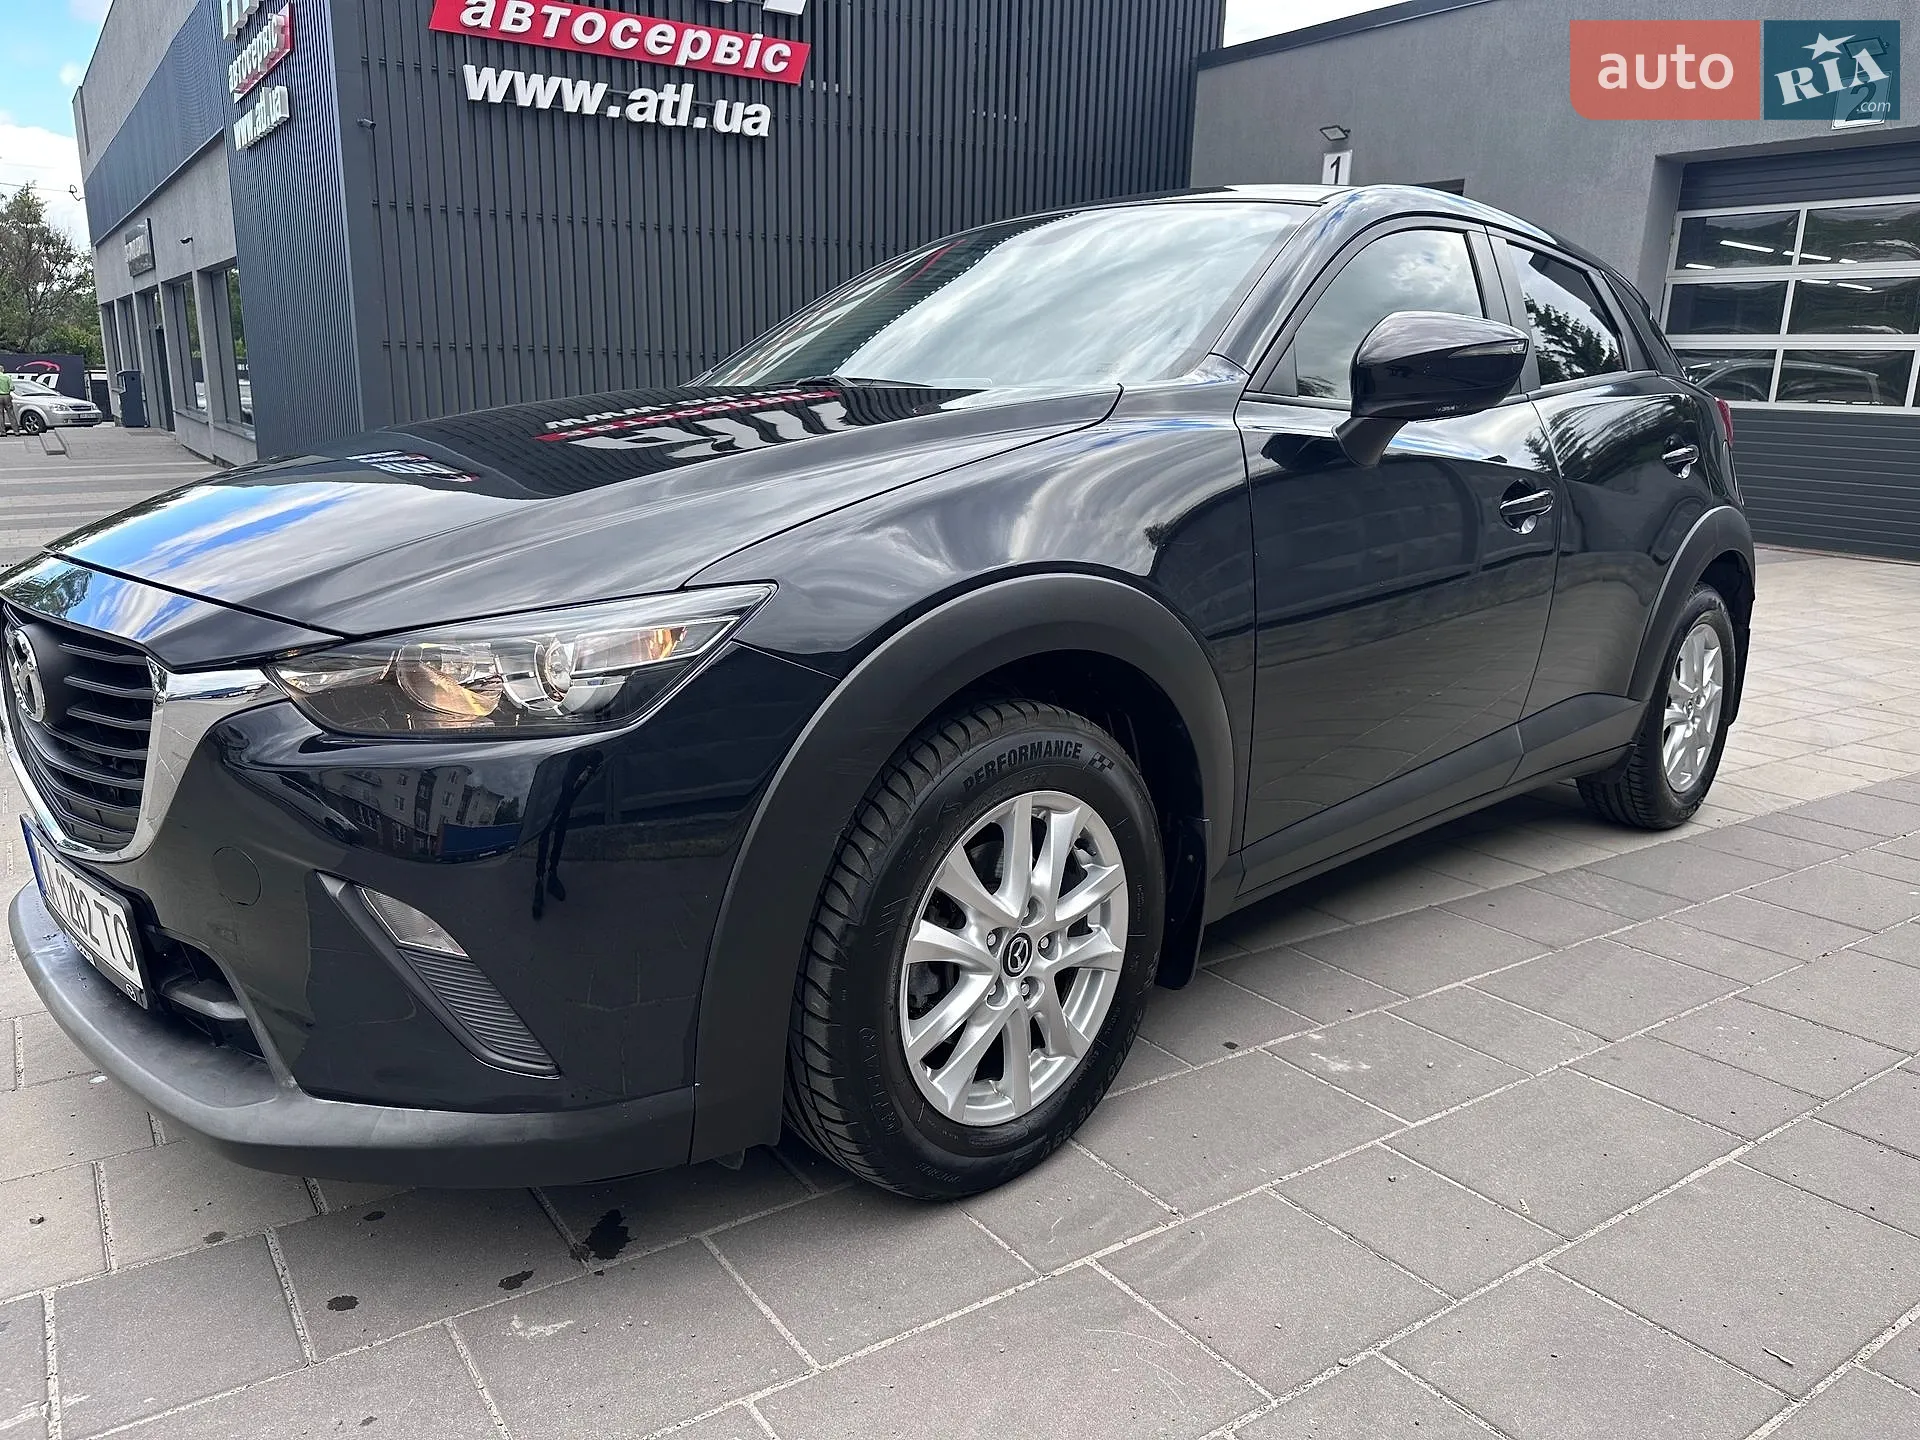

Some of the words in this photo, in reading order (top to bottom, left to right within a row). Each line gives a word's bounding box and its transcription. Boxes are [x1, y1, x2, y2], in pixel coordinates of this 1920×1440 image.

[459, 0, 793, 74] автосервіс
[462, 64, 770, 137] www.atl.ua
[1330, 155, 1341, 185] 1
[962, 740, 1083, 793] PERFORMANCE
[93, 899, 135, 971] TO
